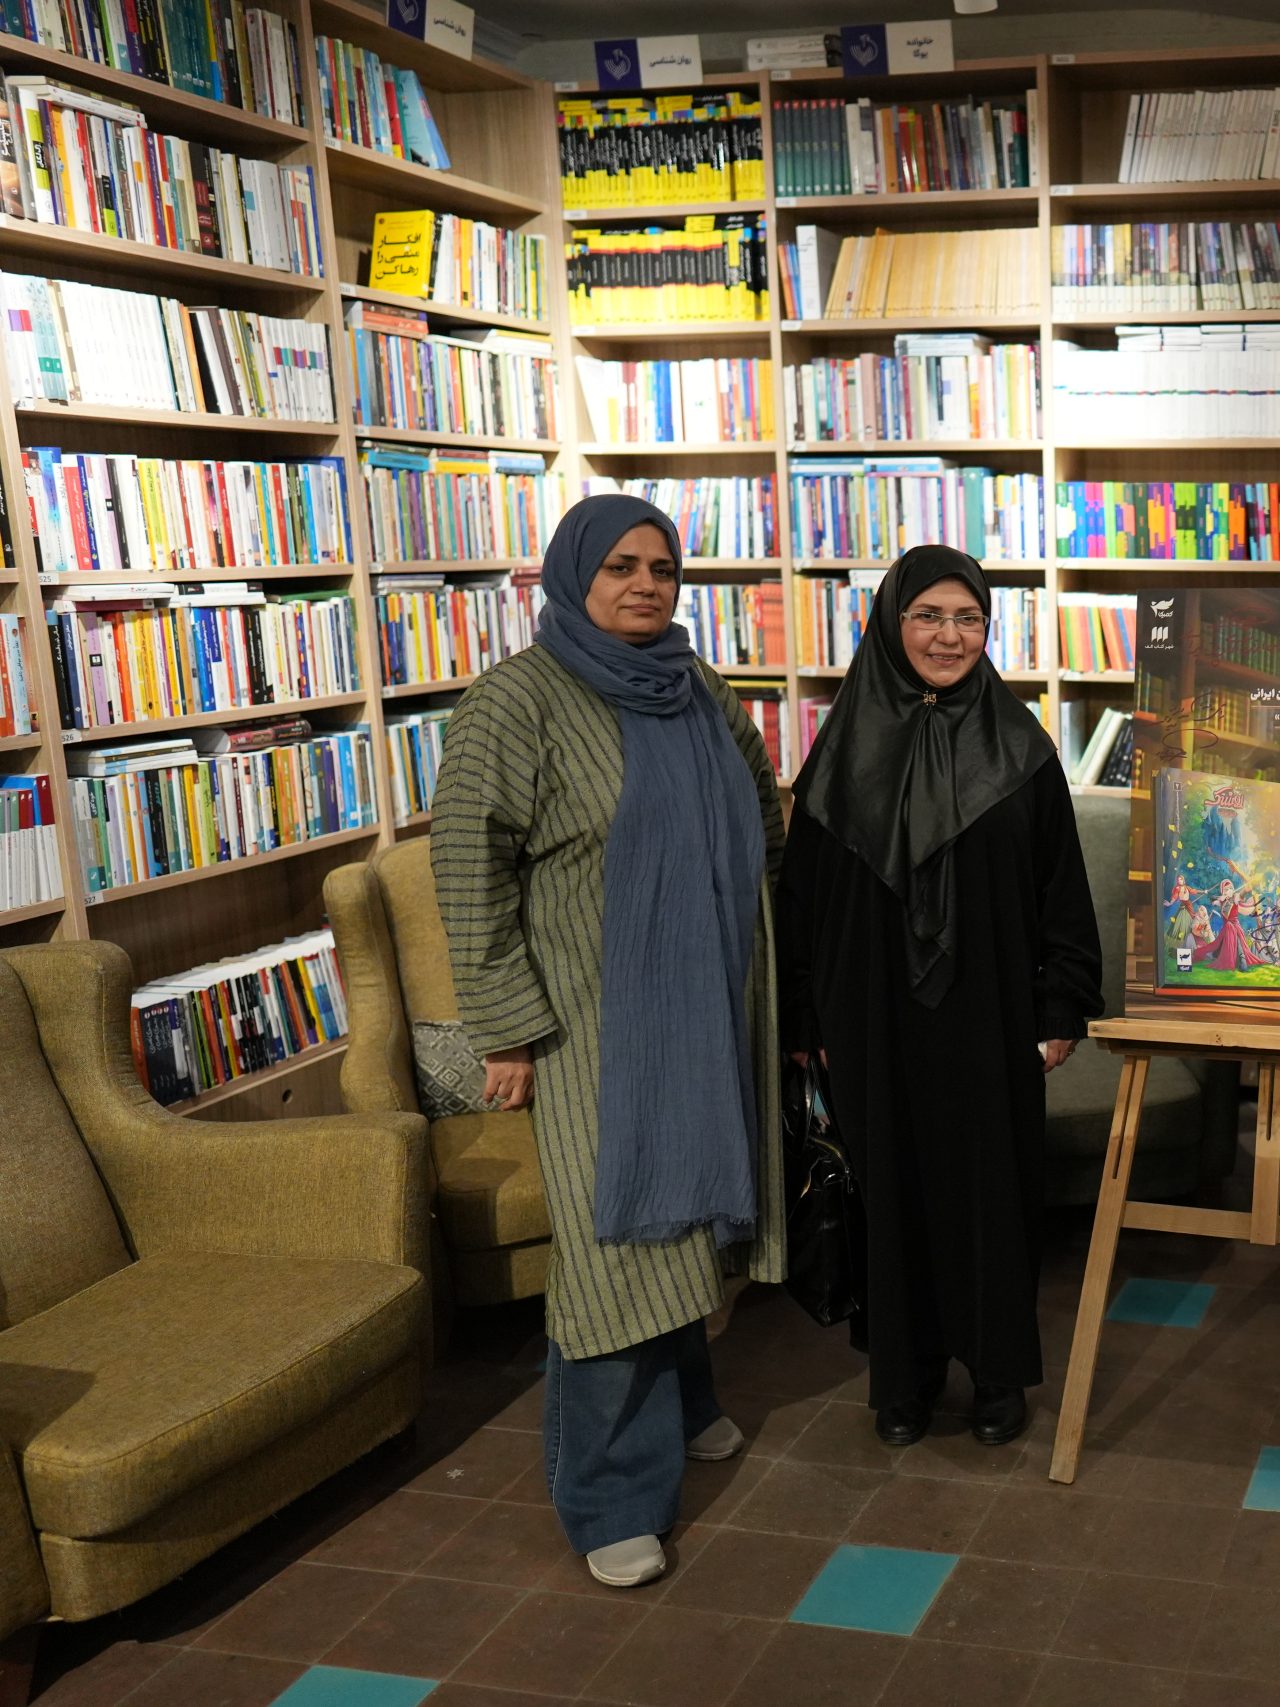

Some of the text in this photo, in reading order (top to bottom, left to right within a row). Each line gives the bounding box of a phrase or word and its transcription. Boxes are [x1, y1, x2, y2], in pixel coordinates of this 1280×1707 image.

[378, 233, 422, 248] افکار
[377, 250, 384, 264] را
[375, 263, 419, 280] رها کن
[1250, 687, 1275, 701] ایرانی
